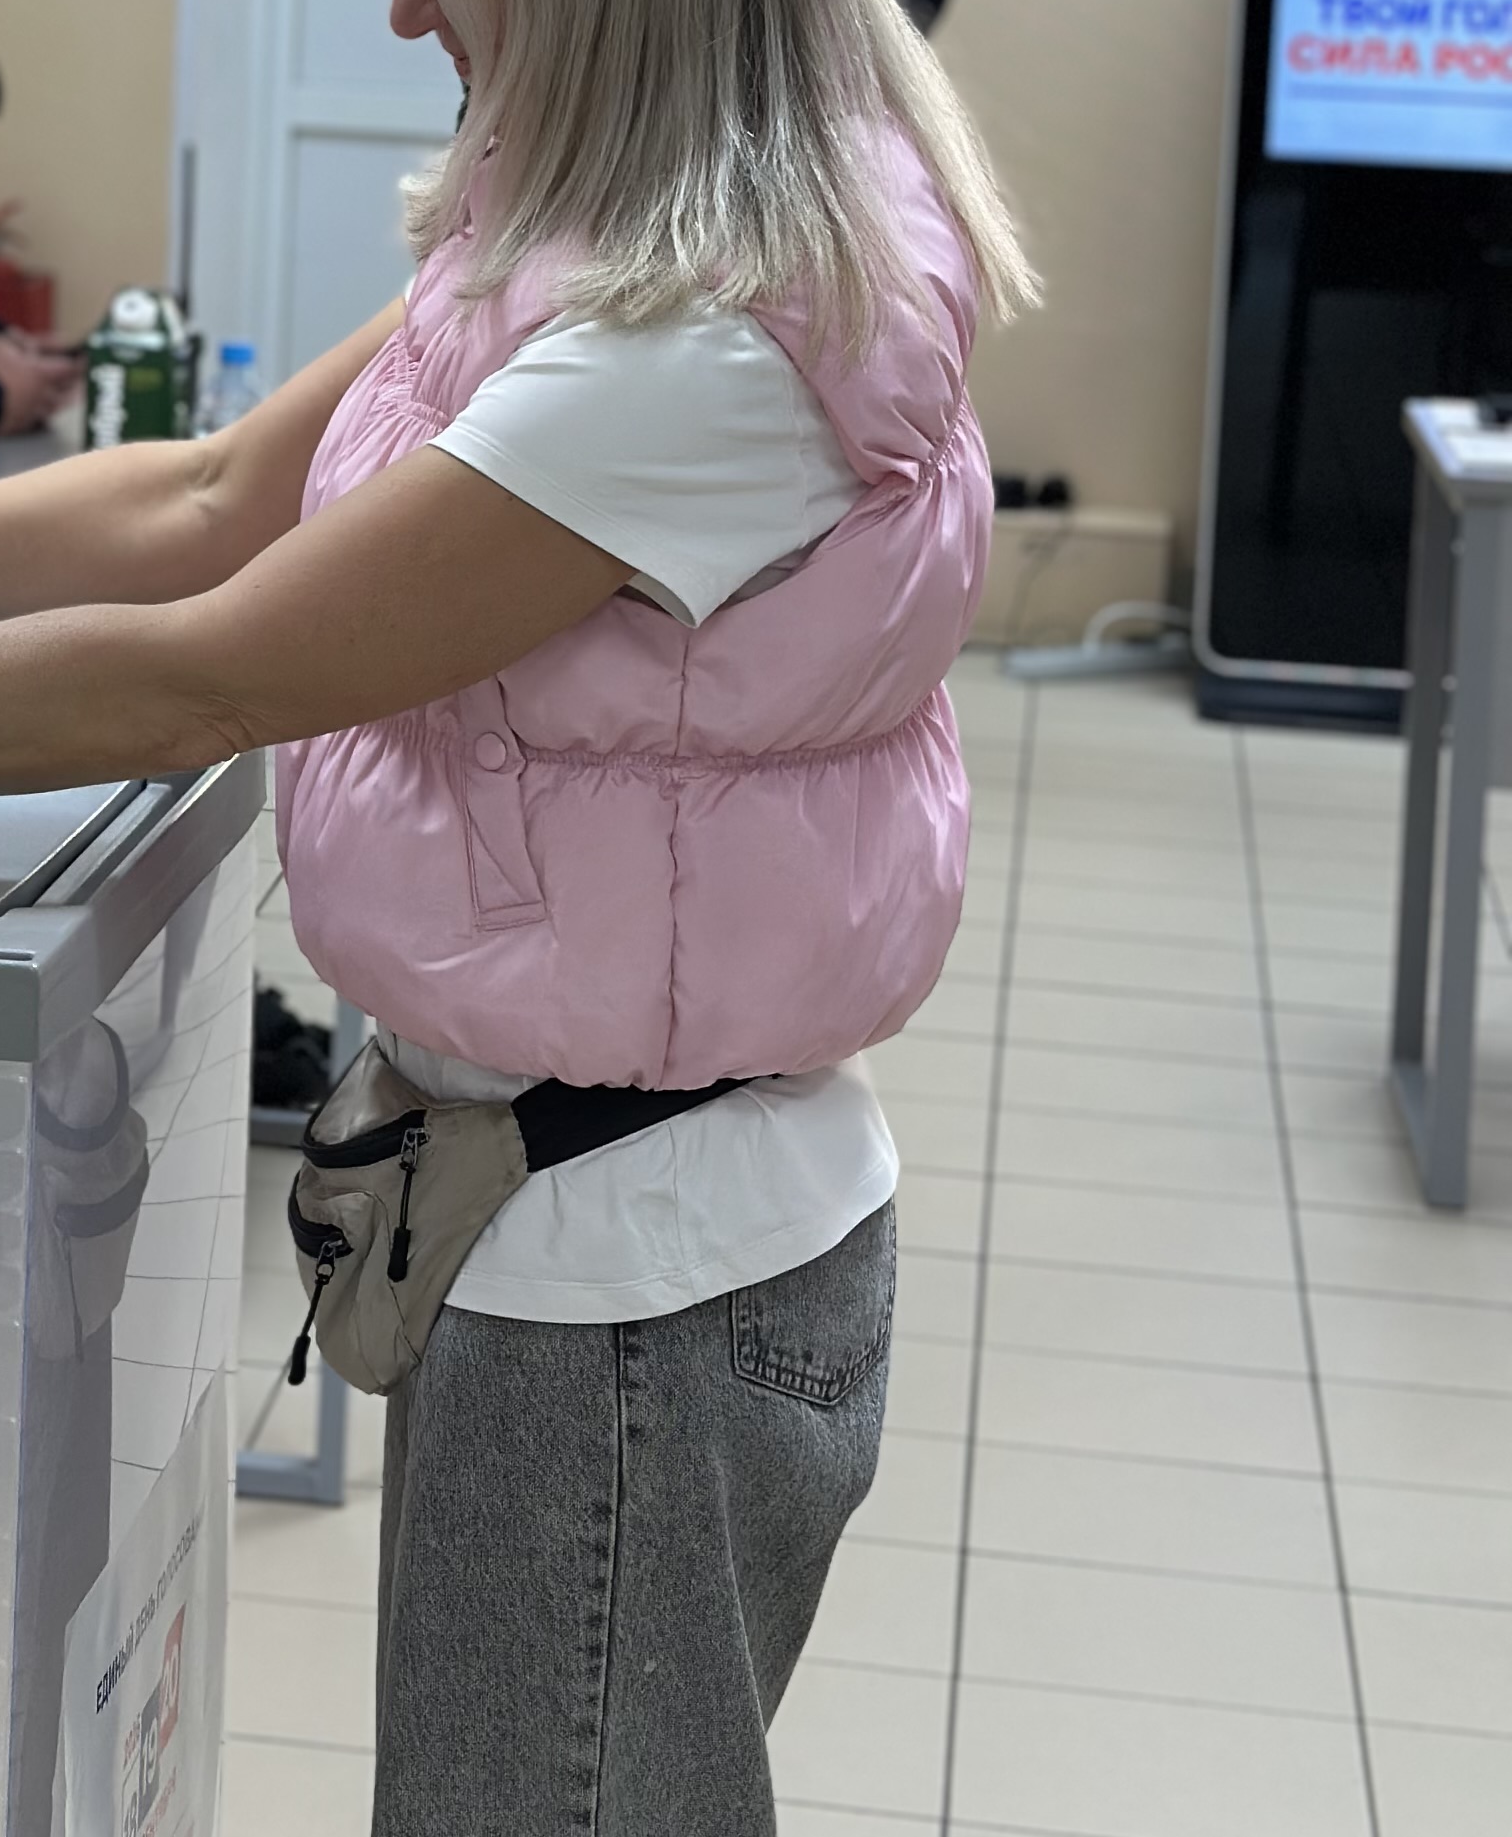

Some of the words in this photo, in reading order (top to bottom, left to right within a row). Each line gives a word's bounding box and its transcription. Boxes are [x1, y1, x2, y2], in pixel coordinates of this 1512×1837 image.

[1287, 32, 1421, 78] СИЛА
[96, 1620, 135, 1715] ЕДИНЫЙ
[140, 1716, 158, 1797] 19
